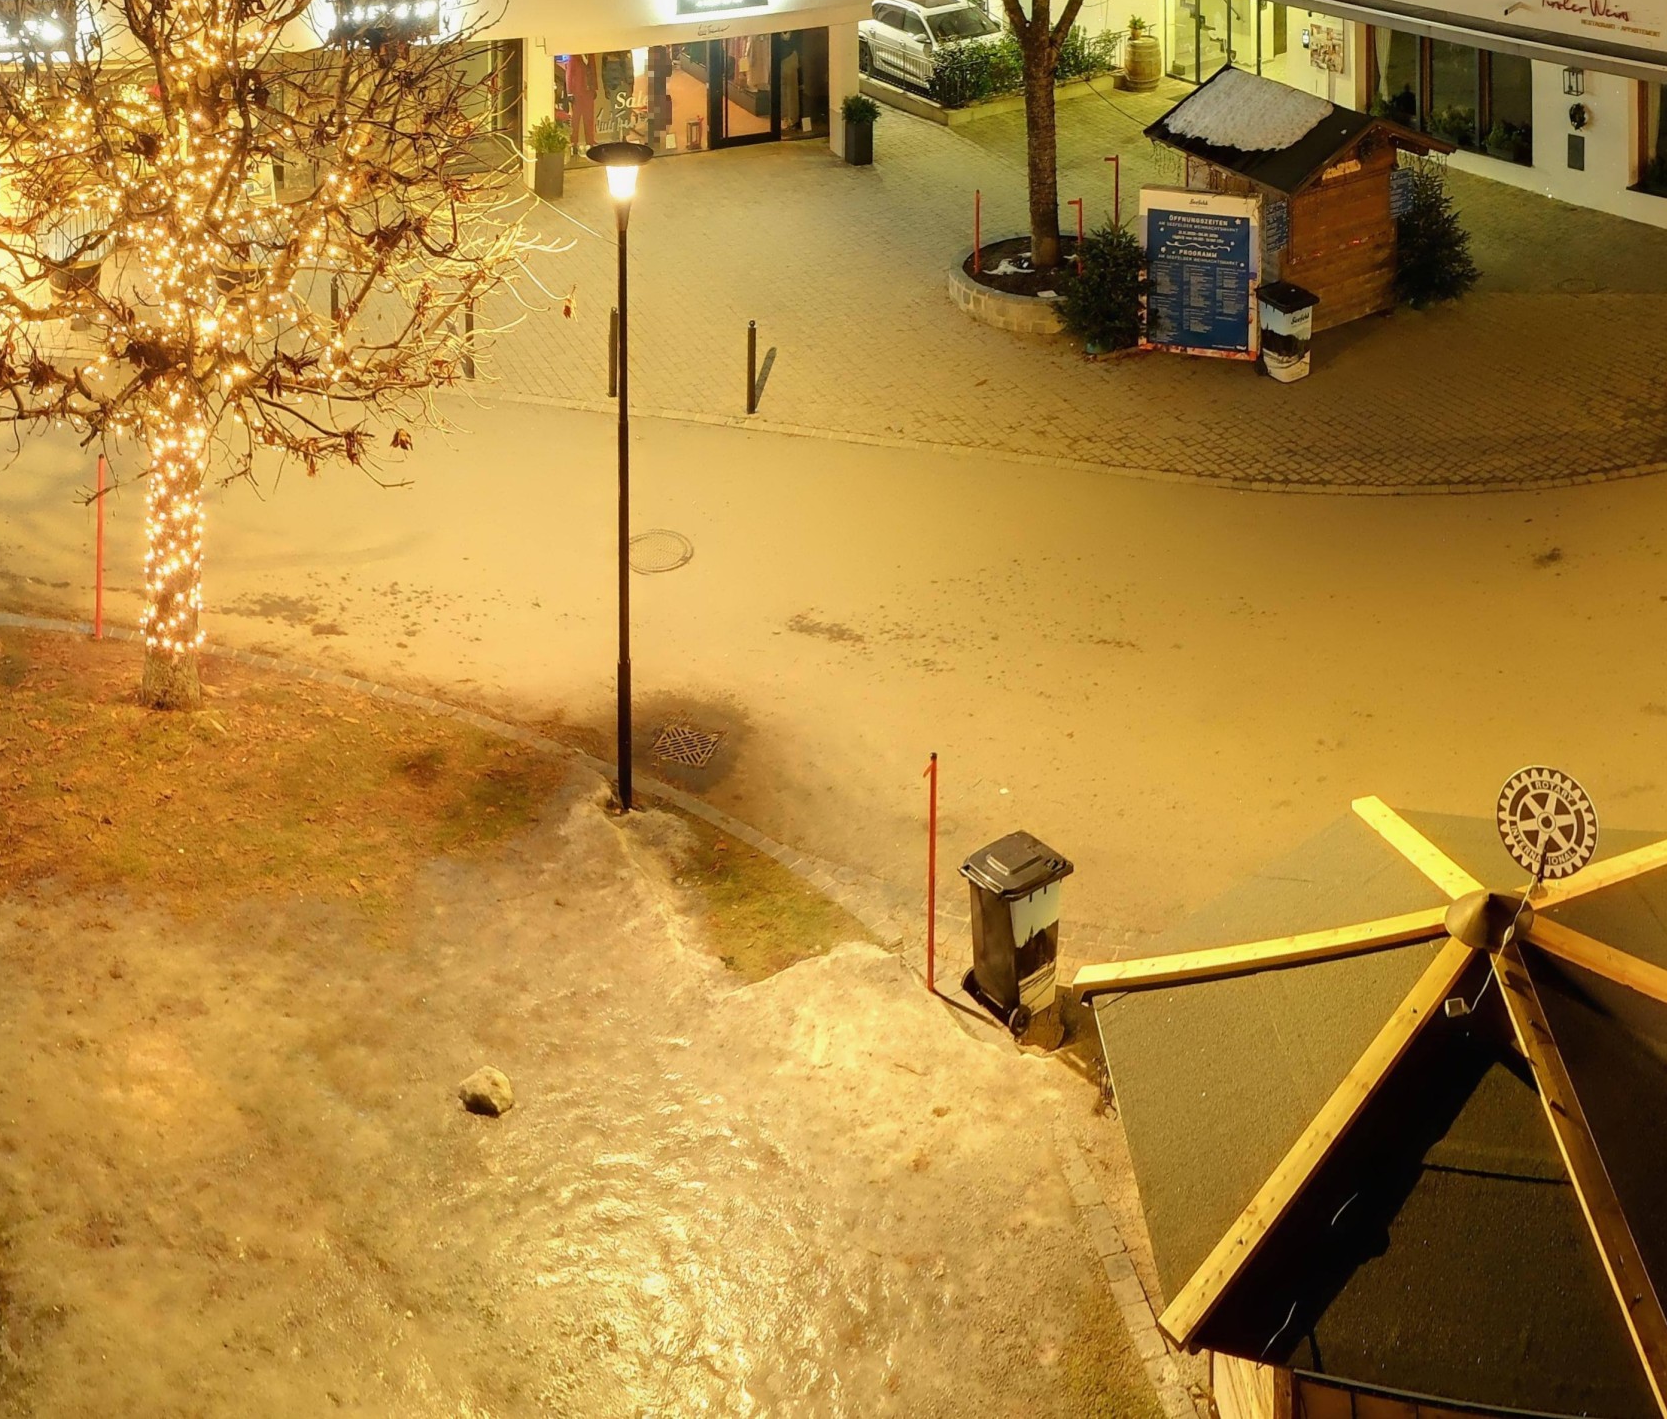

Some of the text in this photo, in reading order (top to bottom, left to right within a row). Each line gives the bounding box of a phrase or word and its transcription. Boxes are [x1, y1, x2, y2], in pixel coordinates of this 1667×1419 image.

[1169, 214, 1228, 226] ÖFFNUNGSZEITEN
[1178, 249, 1217, 258] PROGRAMM
[1535, 781, 1575, 802] ROTARY
[1510, 824, 1577, 866] INTERNAIONAL
